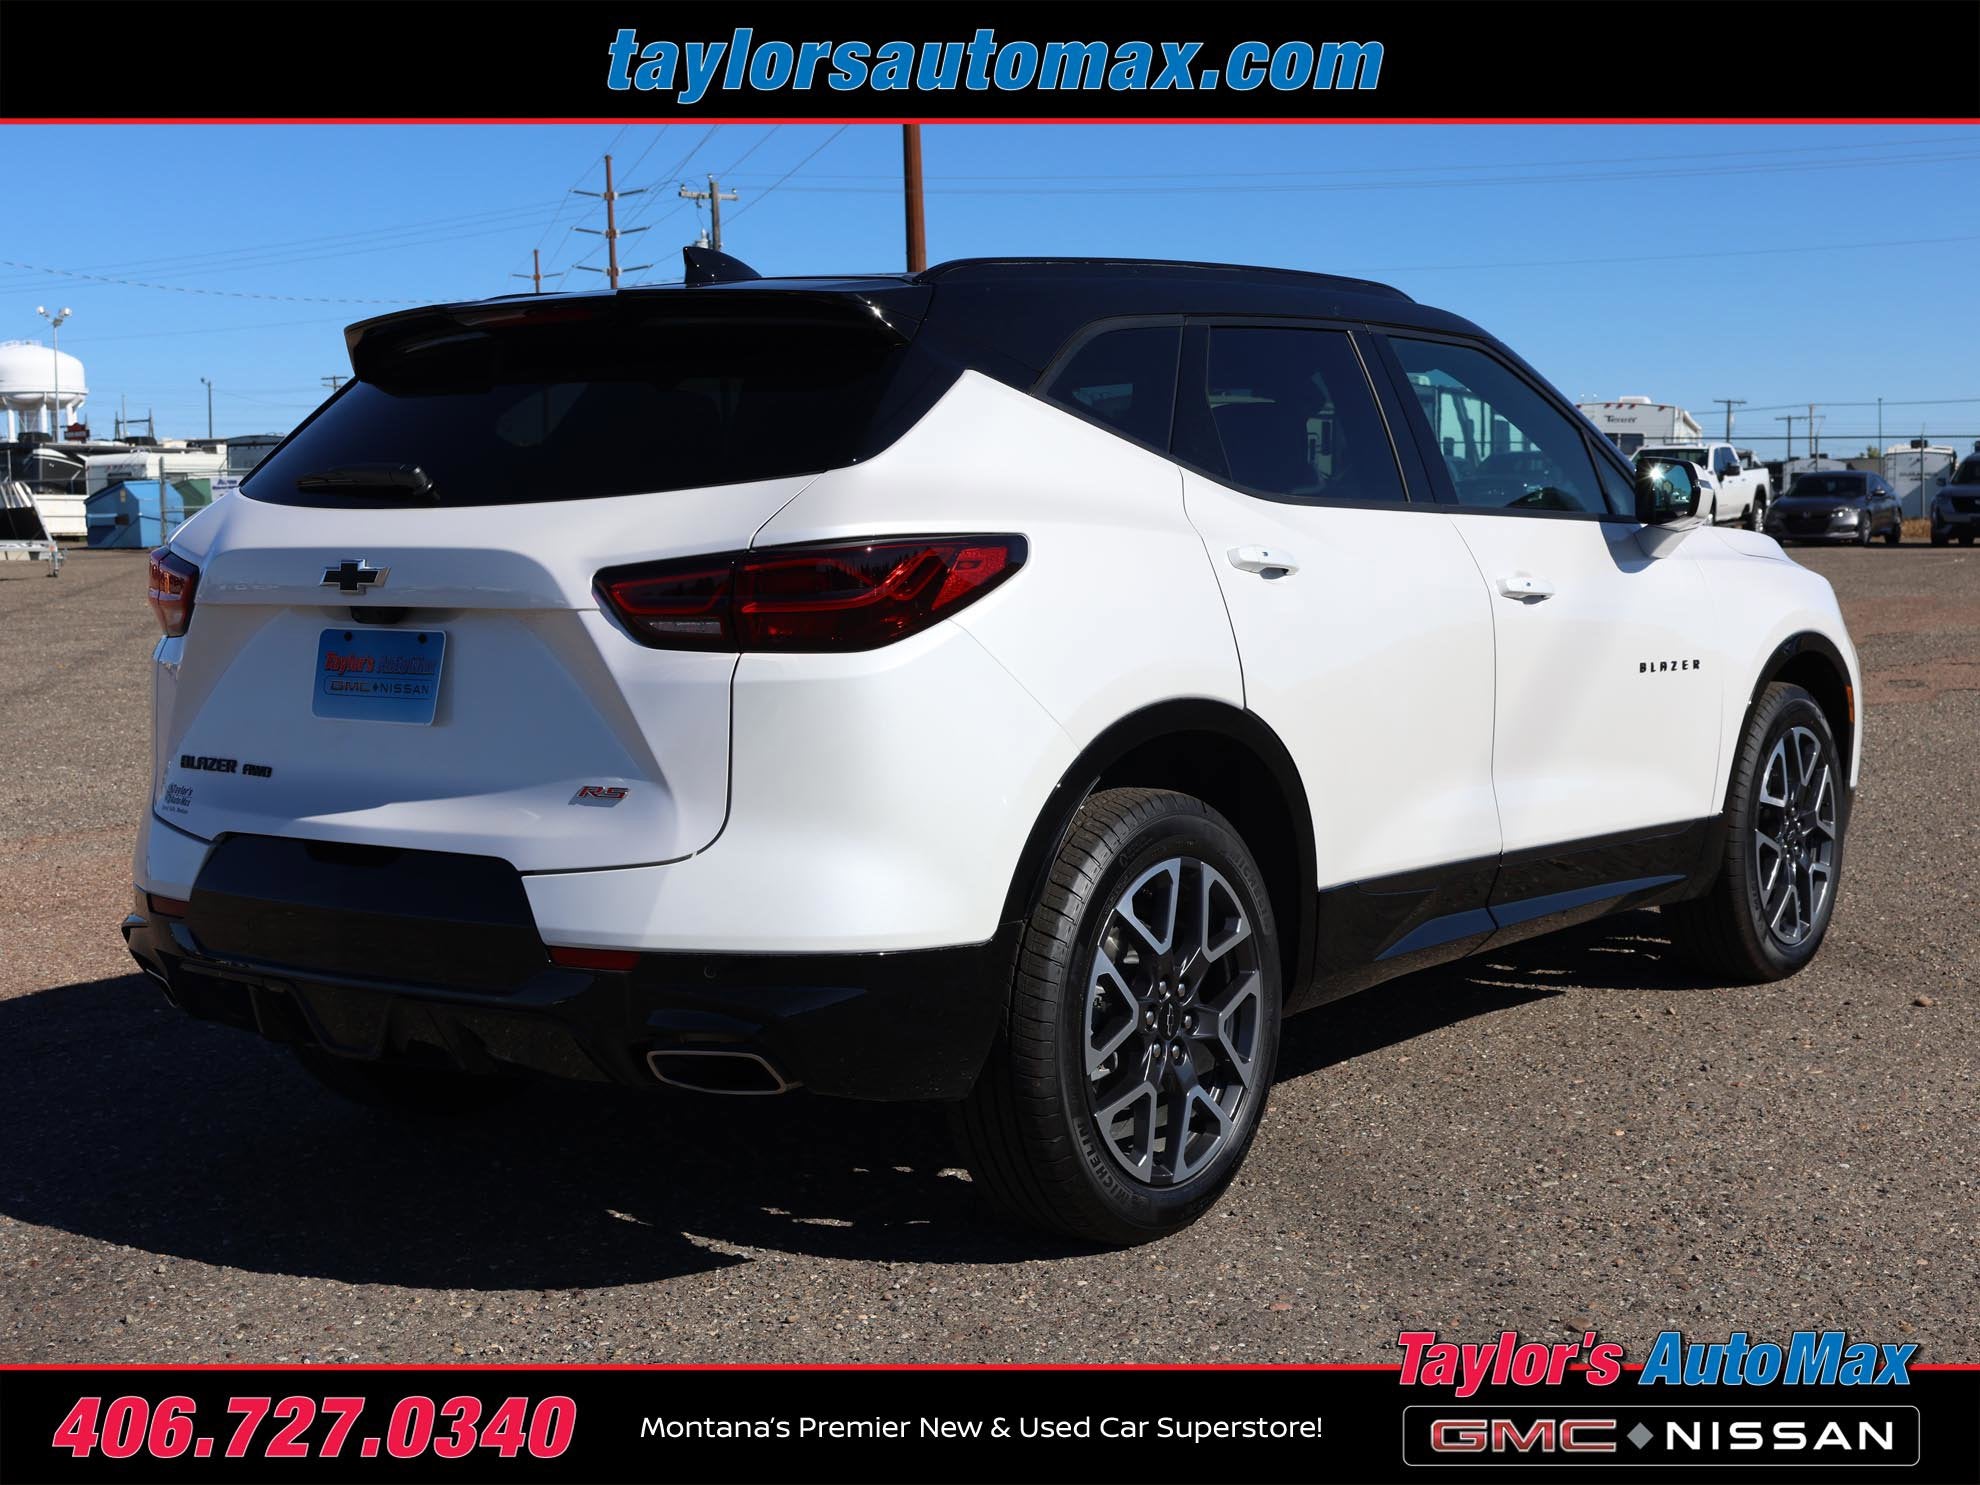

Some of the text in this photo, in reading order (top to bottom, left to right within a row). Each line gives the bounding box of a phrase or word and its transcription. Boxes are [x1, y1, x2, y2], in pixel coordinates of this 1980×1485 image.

[324, 651, 375, 676] Taylor's
[1639, 659, 1701, 673] BLAZER
[329, 680, 429, 695] GMC NISSAN
[180, 755, 273, 778] BLAZER AWD
[577, 785, 629, 799] RS
